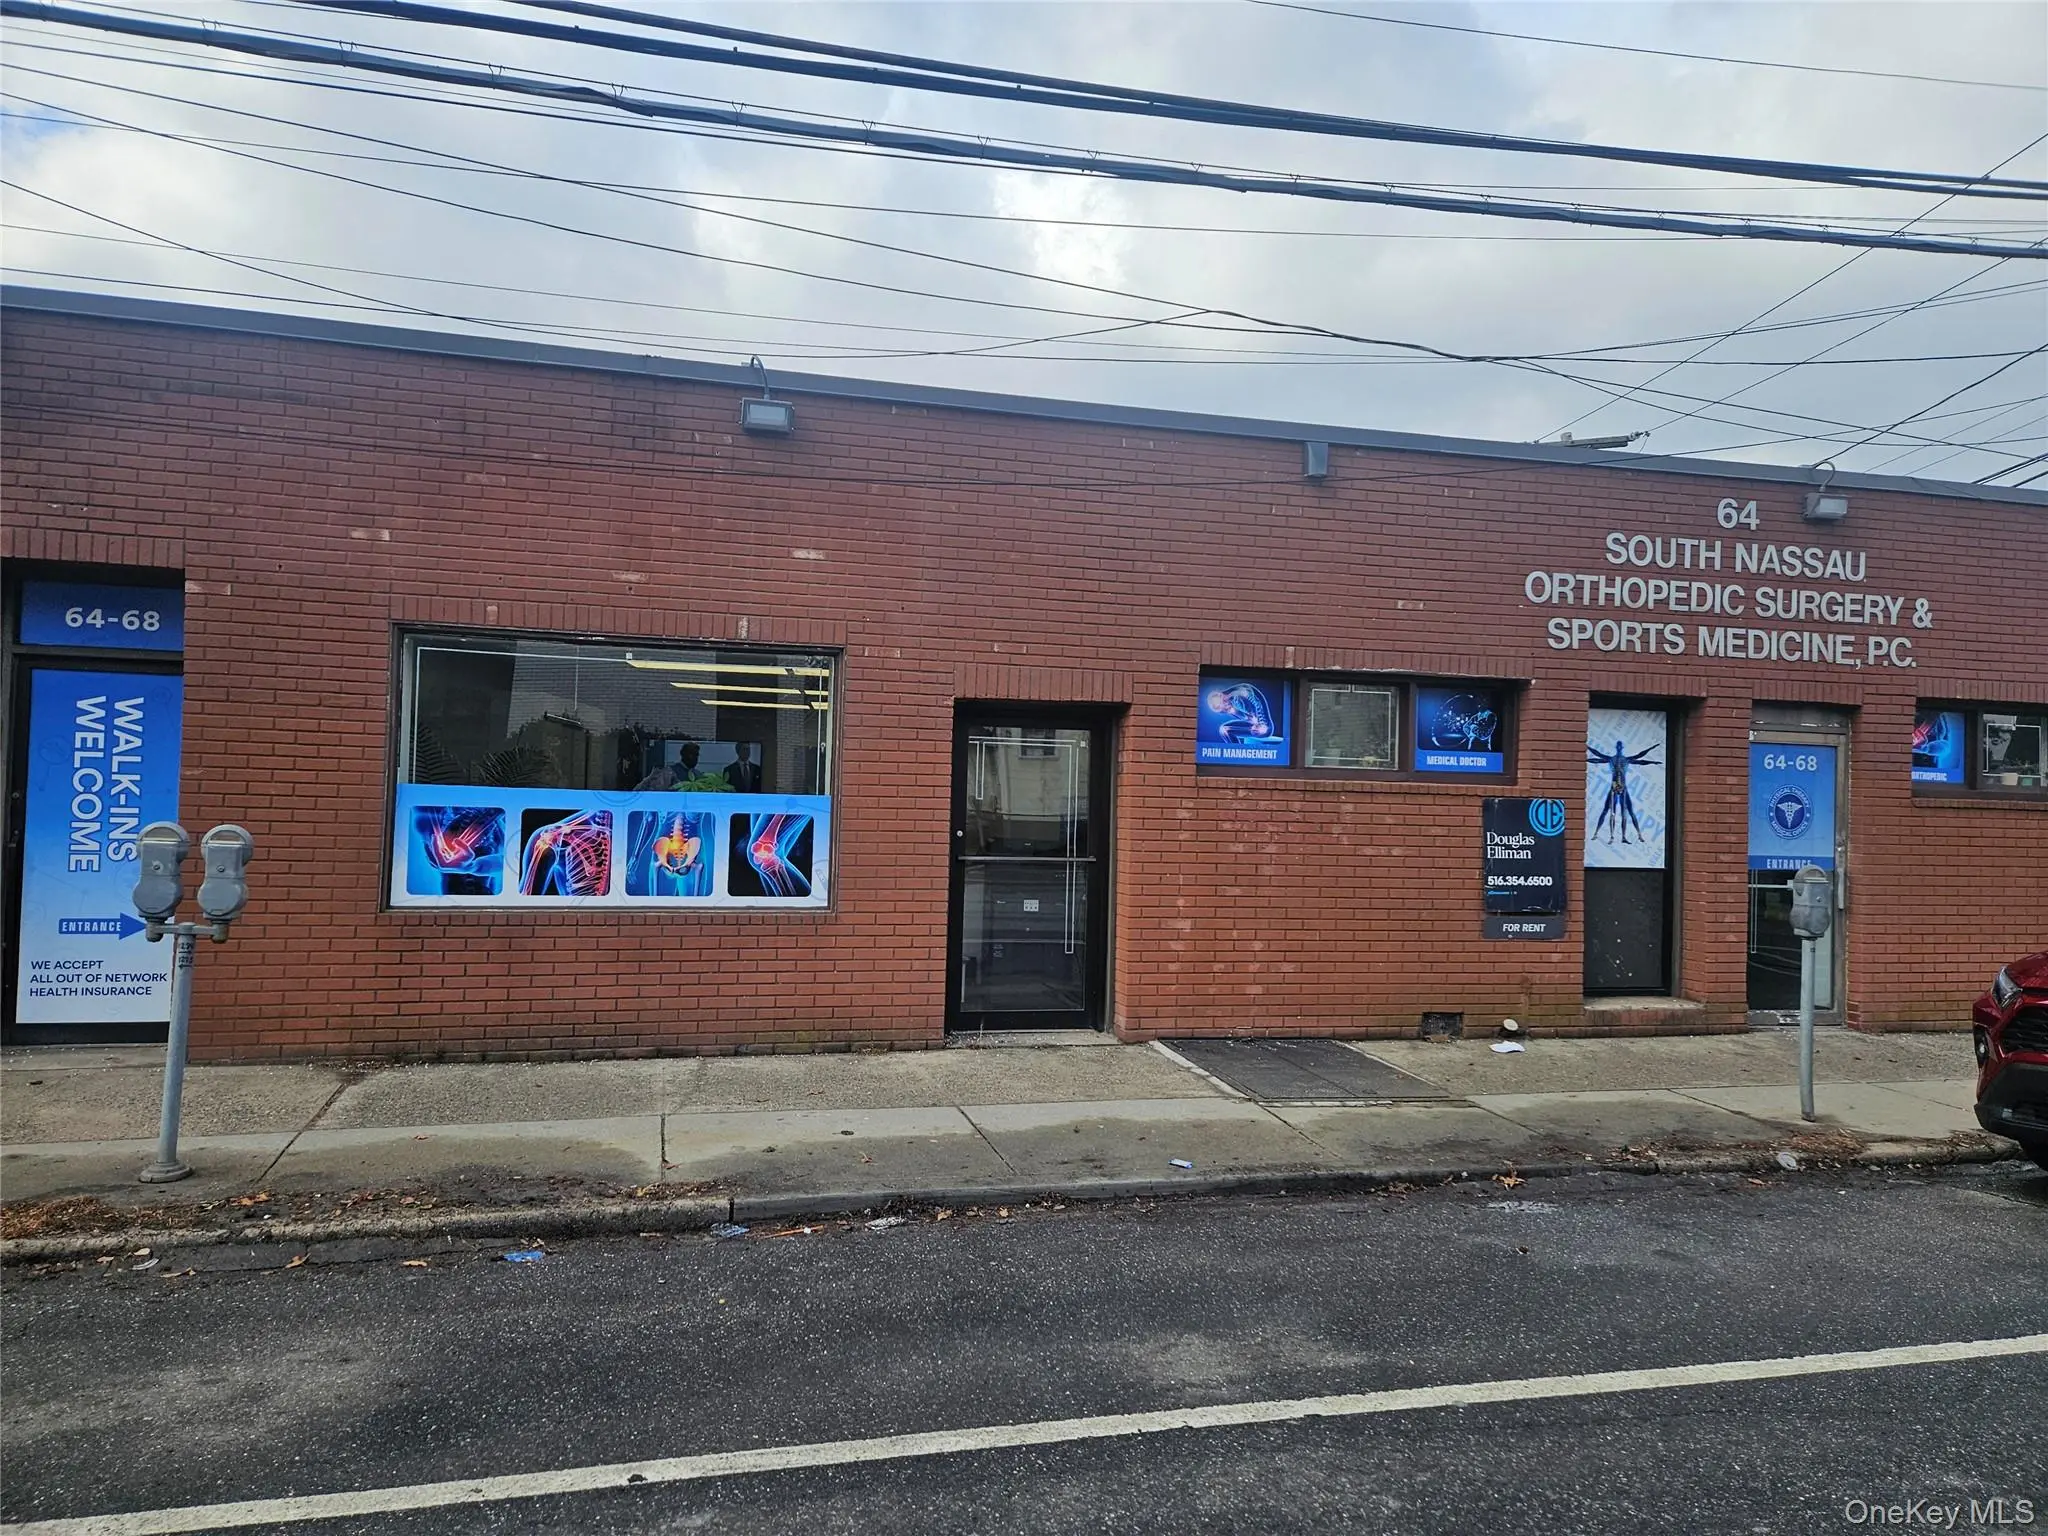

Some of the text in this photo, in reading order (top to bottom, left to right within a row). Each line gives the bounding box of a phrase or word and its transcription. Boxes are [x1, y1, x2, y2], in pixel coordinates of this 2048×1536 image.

[1717, 498, 1760, 531] 64
[1606, 532, 1866, 581] SOUTH NASSAU
[1524, 571, 1933, 629] ORTHOPEDIC SURGERY &
[65, 607, 160, 632] 64-68
[1547, 617, 1918, 670] SPORTS MEDICINE, P.C.
[1202, 747, 1277, 759] PAIN MANAGEMENT
[1427, 755, 1487, 767] MEDICAL DOCTOR
[1764, 754, 1818, 770] 64-68
[69, 695, 107, 871] WELCOME
[107, 697, 144, 862] WALK-INS
[1486, 831, 1535, 848] Douglas
[1487, 845, 1532, 859] Elliman
[1487, 875, 1553, 886] 516.354.6500
[61, 921, 121, 932] ENTRANCE
[1502, 923, 1546, 932] FOR RENT
[31, 960, 104, 970] WE ACCEPT
[30, 973, 167, 983] ALL OUT OF NETWORK
[29, 986, 152, 997] HEALTH INSURANCE
